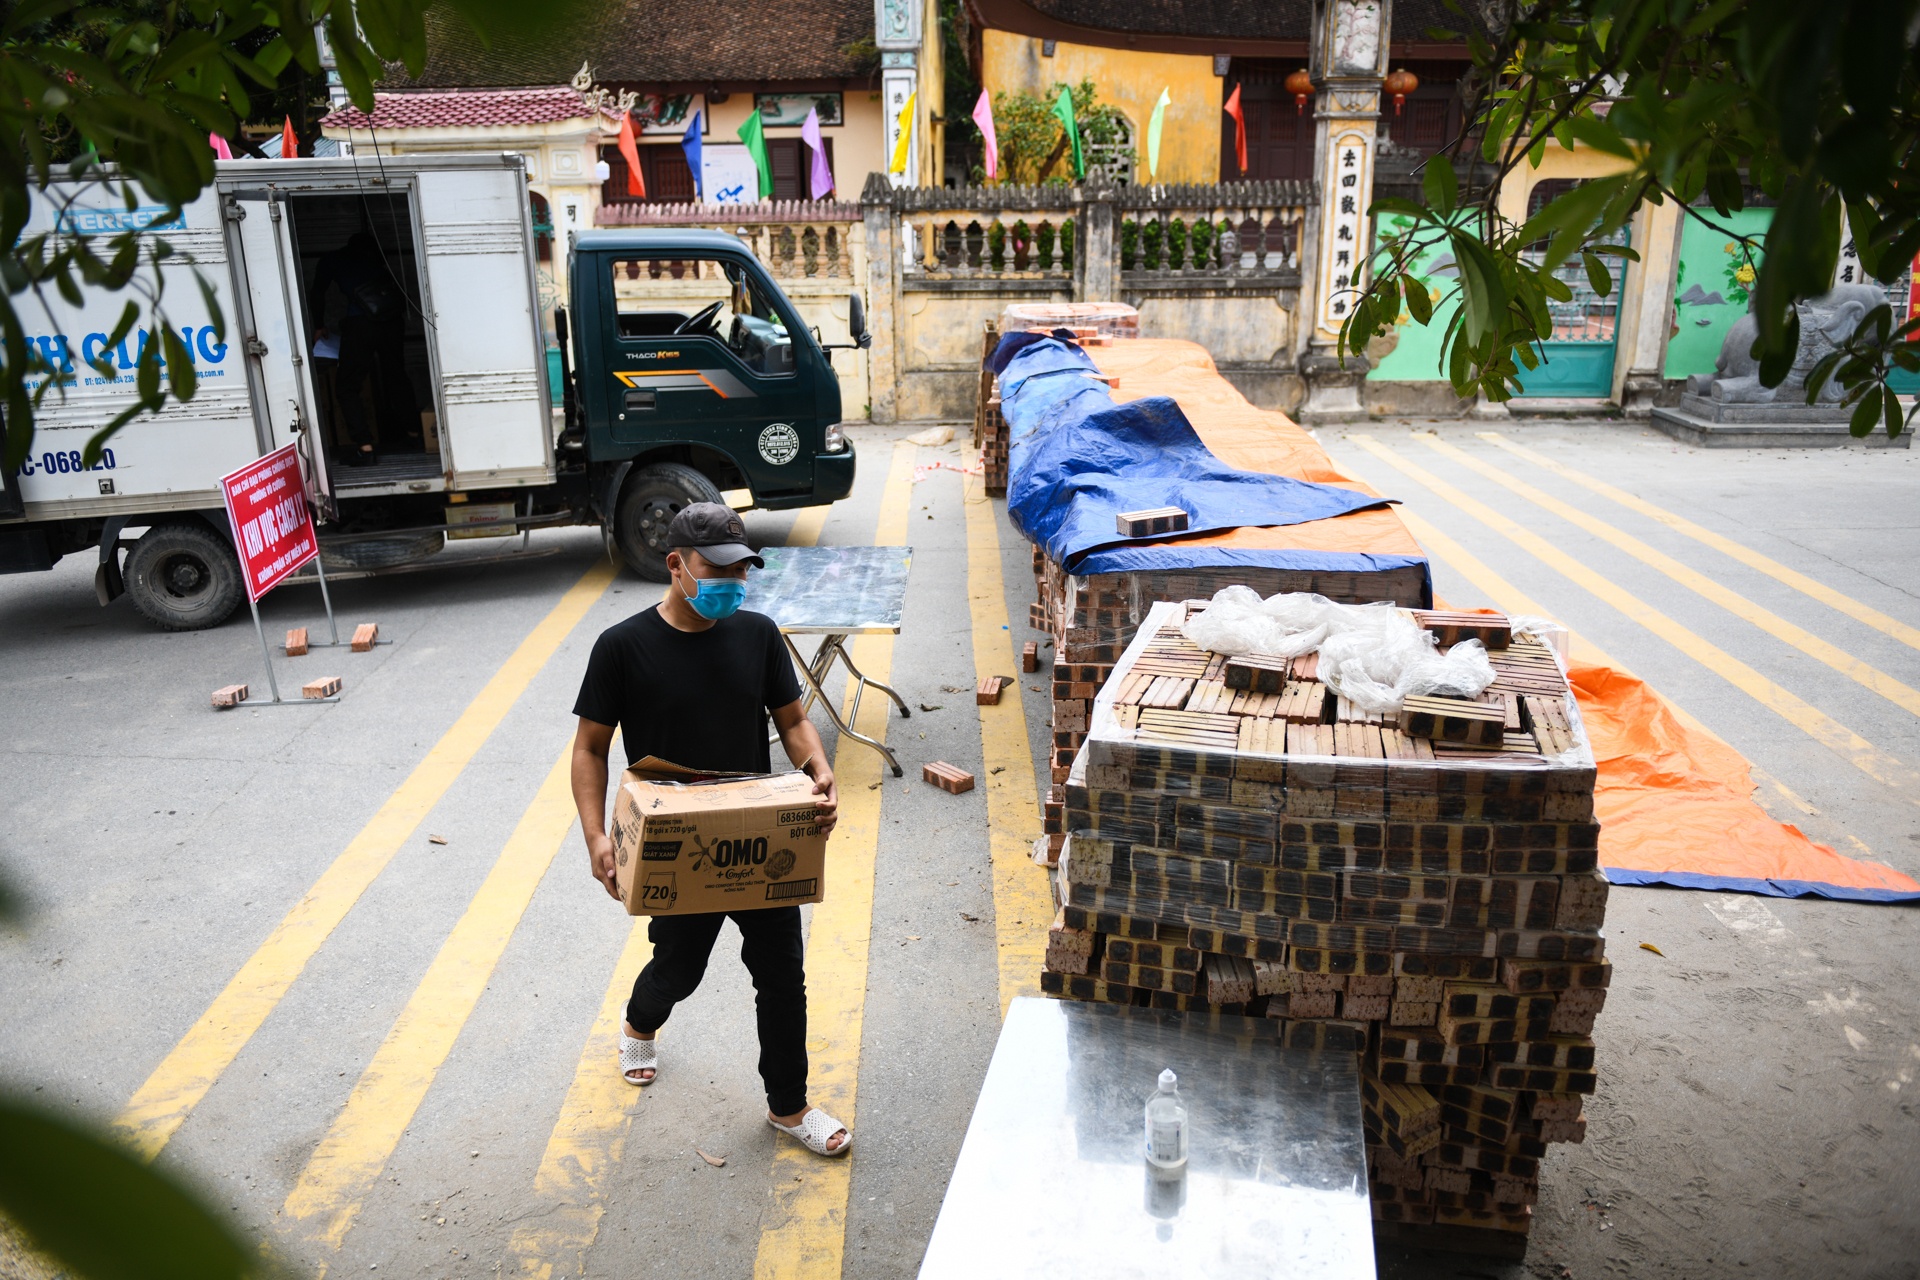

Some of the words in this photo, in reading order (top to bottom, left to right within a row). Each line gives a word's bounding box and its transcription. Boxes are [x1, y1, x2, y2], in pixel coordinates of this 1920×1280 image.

[60, 210, 182, 231] PERFET
[242, 518, 264, 560] KHU
[259, 507, 279, 552] VỰC
[275, 495, 298, 538] CÁCH
[294, 492, 306, 526] LY
[654, 827, 664, 836] gói
[682, 825, 697, 834] g/gói
[791, 826, 805, 840] BỘT
[716, 837, 768, 868] OMO
[725, 868, 755, 882] Comfort
